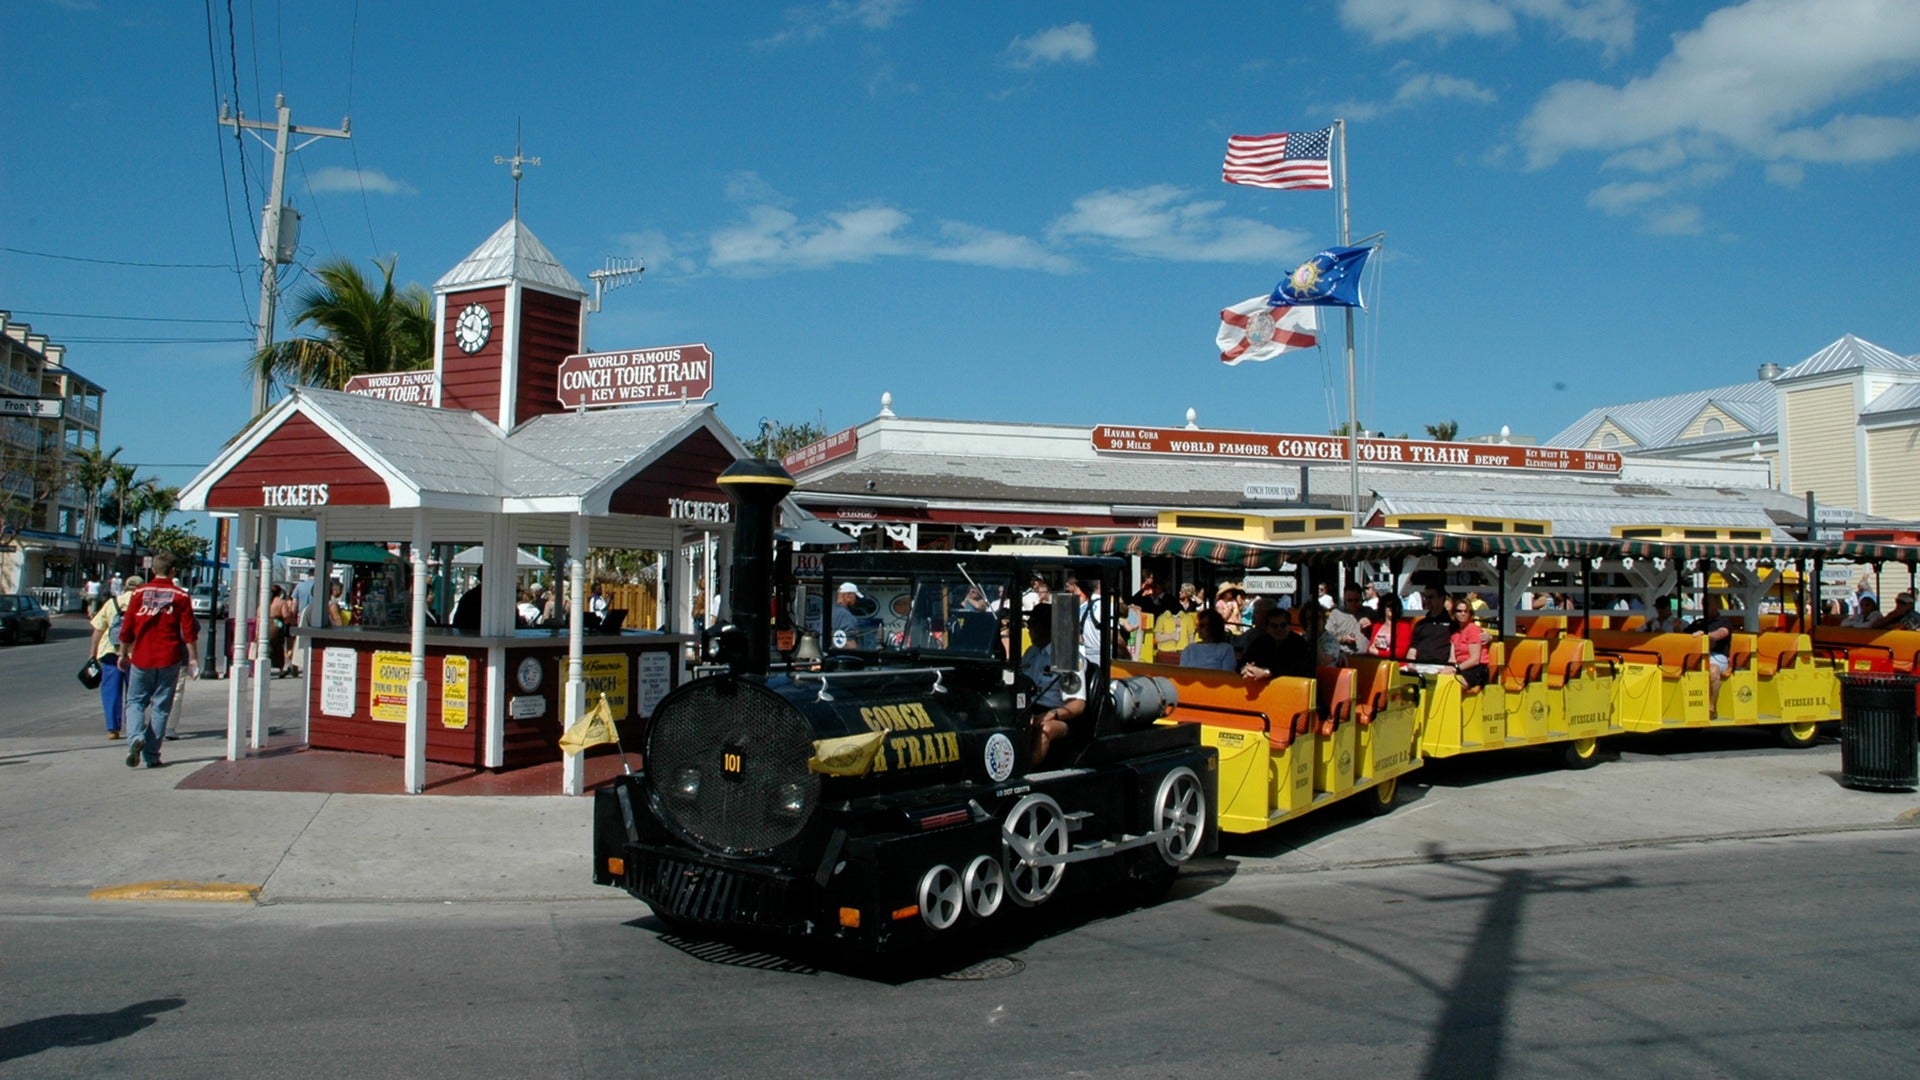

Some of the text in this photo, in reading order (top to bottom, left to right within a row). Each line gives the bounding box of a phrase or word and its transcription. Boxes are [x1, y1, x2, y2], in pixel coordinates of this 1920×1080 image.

[588, 350, 681, 368] WORLD FAMOUS
[368, 373, 434, 387] WORLD FAMOU
[563, 361, 707, 390] CONCH TOUR TRAIN
[388, 386, 420, 402] TOUR
[592, 388, 616, 400] KEY
[658, 384, 676, 396] FL.
[4, 400, 44, 411] Front St
[1111, 439, 1123, 449] 90
[1170, 440, 1509, 466] WORLD FAMOUS CONCH TOUR TRAIN DEPOT
[1560, 451, 1569, 459] FL
[1607, 453, 1616, 461] FL
[262, 484, 329, 507] TICKETS
[1246, 486, 1264, 495] CONCH
[1265, 486, 1279, 495] TOUR
[668, 498, 730, 523] TICKETS
[445, 666, 457, 685] 90
[860, 702, 935, 731] CONCH
[890, 731, 960, 769] TRAIN
[725, 753, 740, 773] 101
